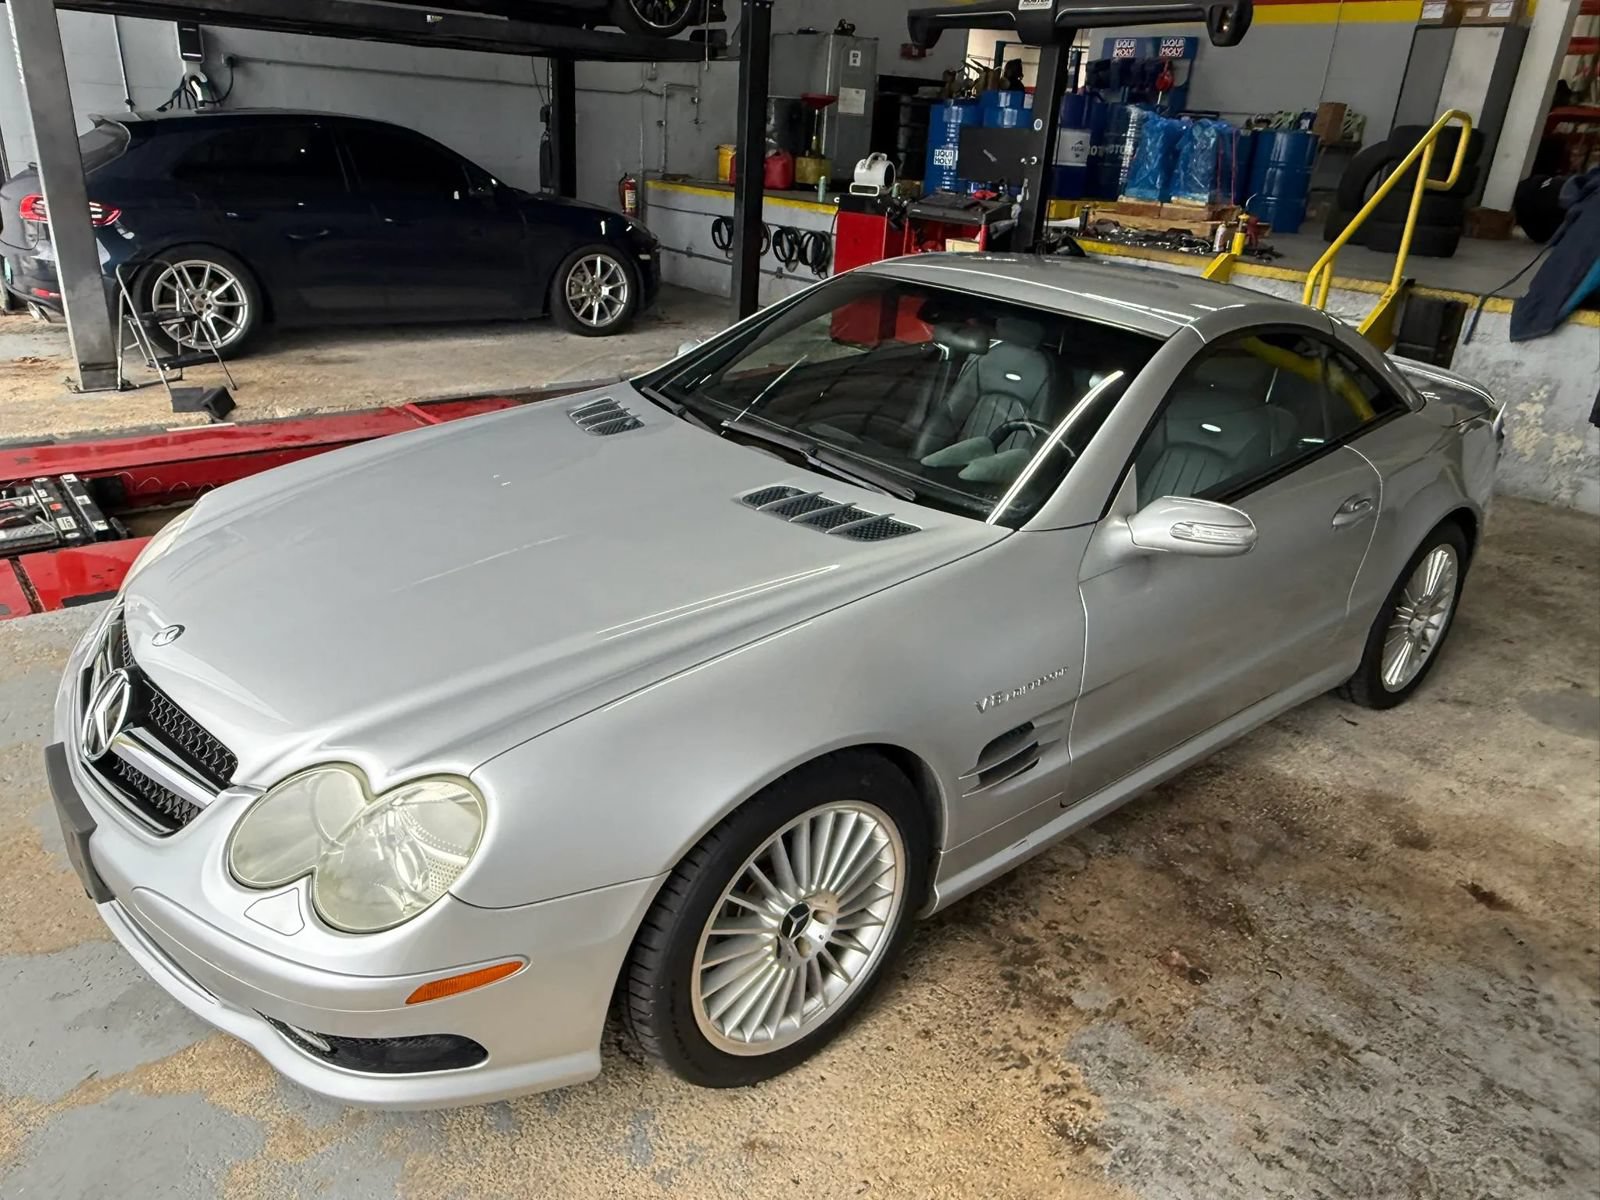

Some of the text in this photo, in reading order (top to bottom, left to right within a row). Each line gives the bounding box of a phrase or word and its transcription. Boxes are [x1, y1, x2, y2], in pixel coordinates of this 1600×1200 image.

[1114, 48, 1135, 57] MOLY
[1160, 47, 1184, 56] MOLY
[935, 150, 953, 158] LIQUI
[934, 157, 953, 165] MOLY
